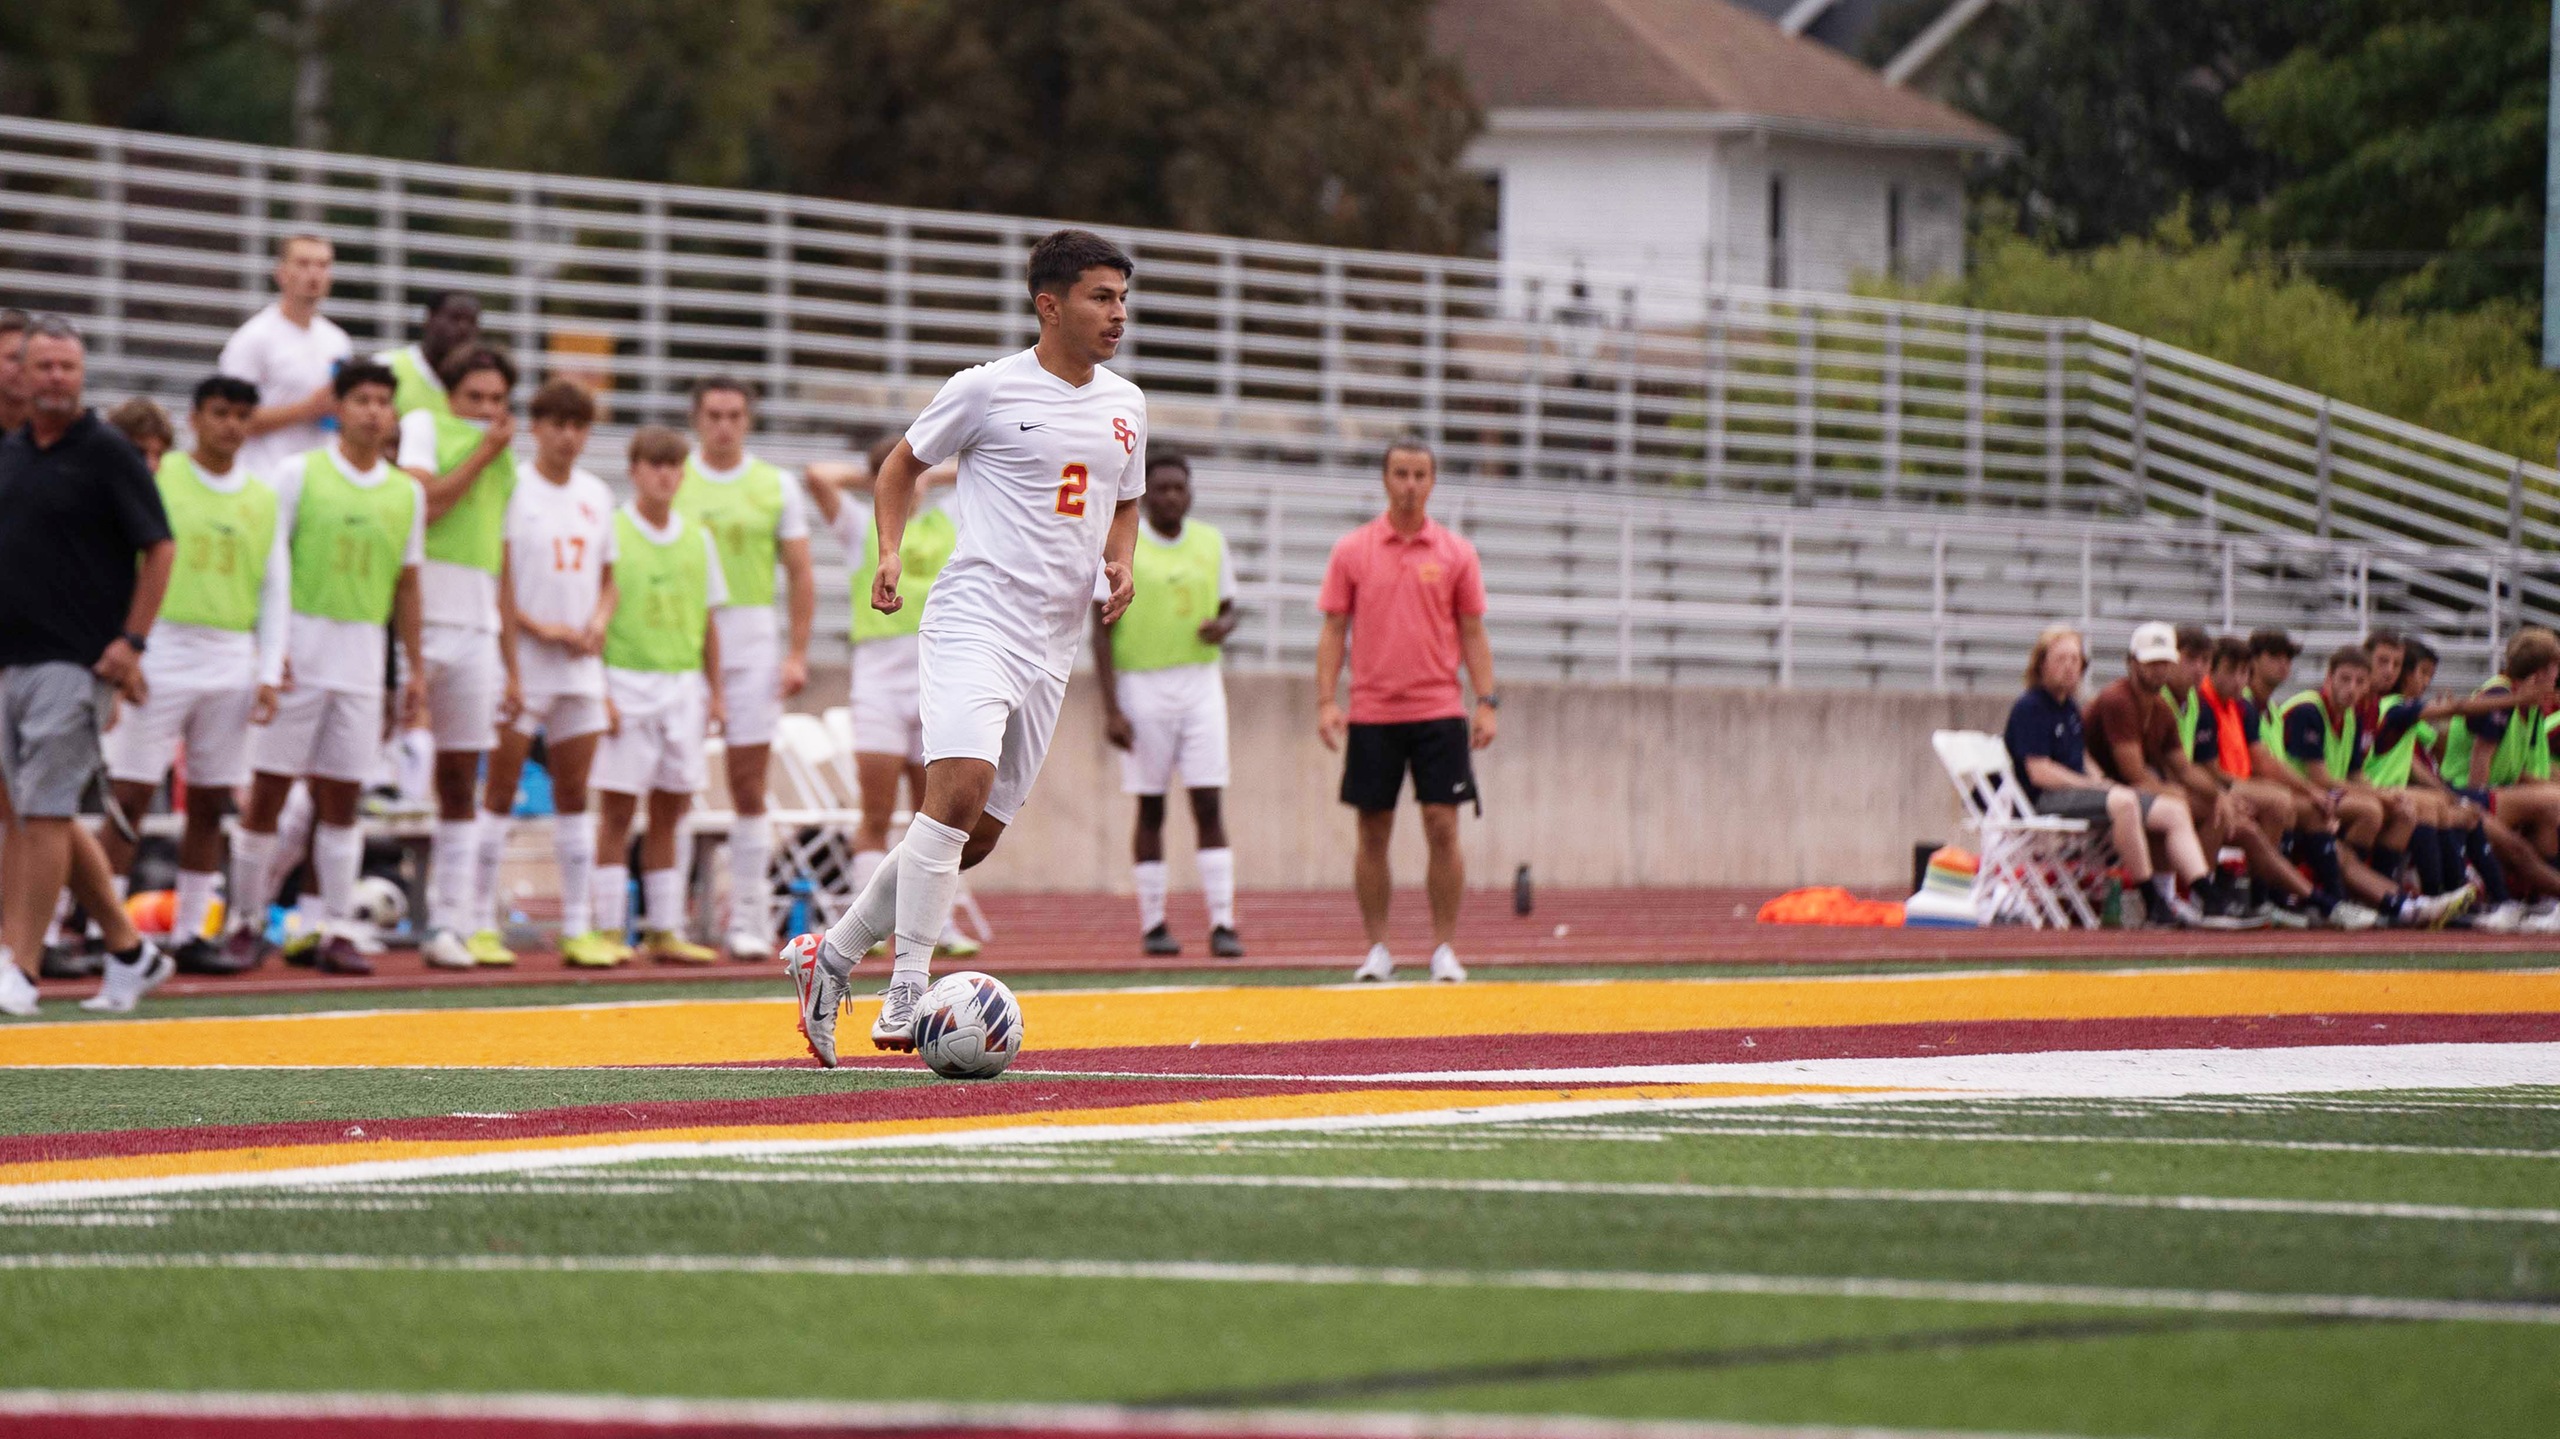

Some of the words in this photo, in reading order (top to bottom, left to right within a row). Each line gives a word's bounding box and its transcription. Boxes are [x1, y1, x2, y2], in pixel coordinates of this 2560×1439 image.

[1112, 417, 1136, 455] SC
[1055, 462, 1088, 519] 2
[553, 537, 585, 572] 17
